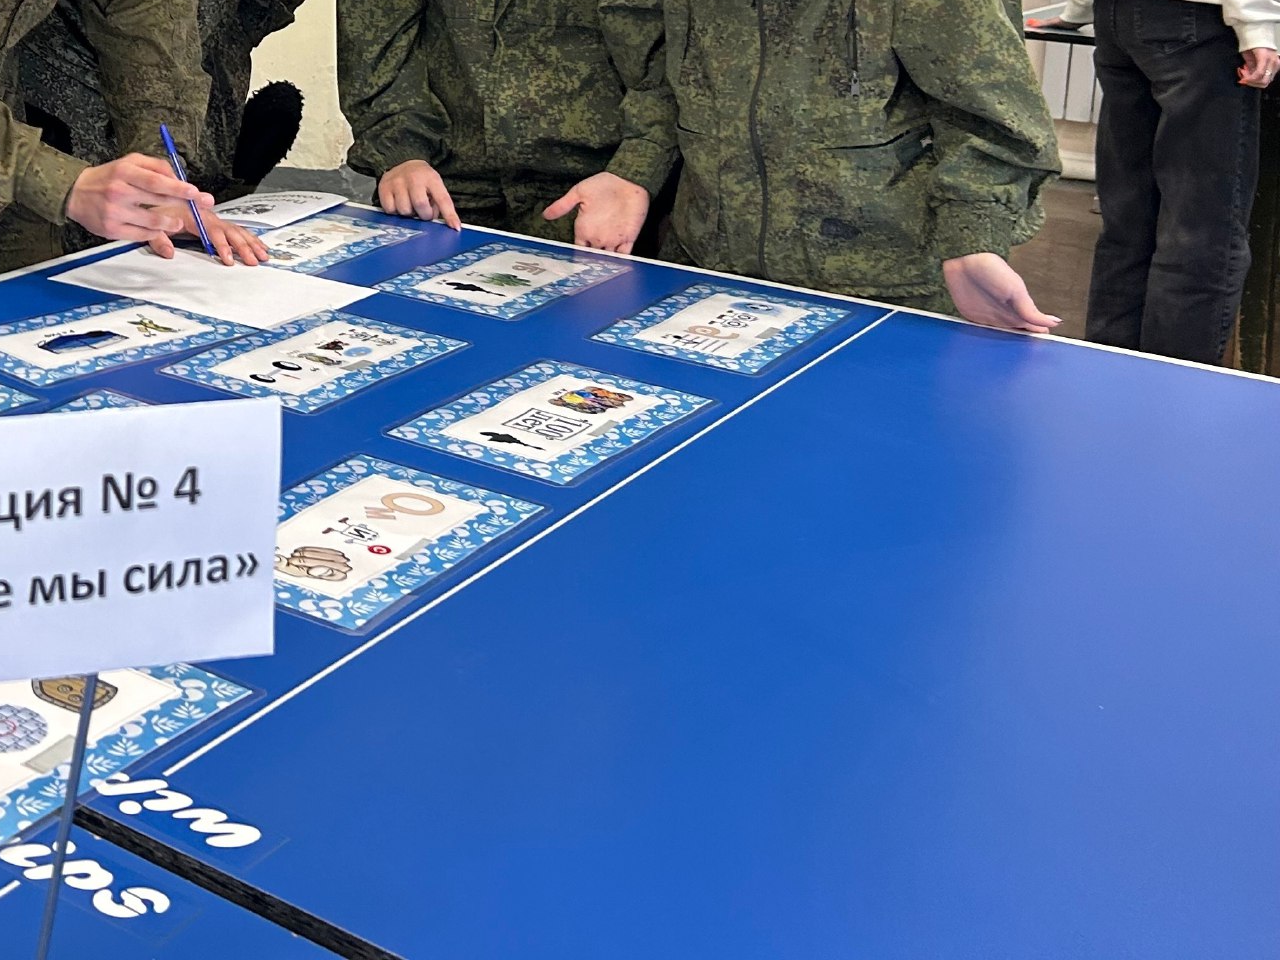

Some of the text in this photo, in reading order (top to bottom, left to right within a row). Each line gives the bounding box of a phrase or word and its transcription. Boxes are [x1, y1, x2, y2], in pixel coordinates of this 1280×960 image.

[535, 416, 584, 439] 100
[102, 470, 159, 512] №
[173, 466, 202, 505] 4
[28, 569, 106, 605] мы
[123, 551, 260, 596] сила»
